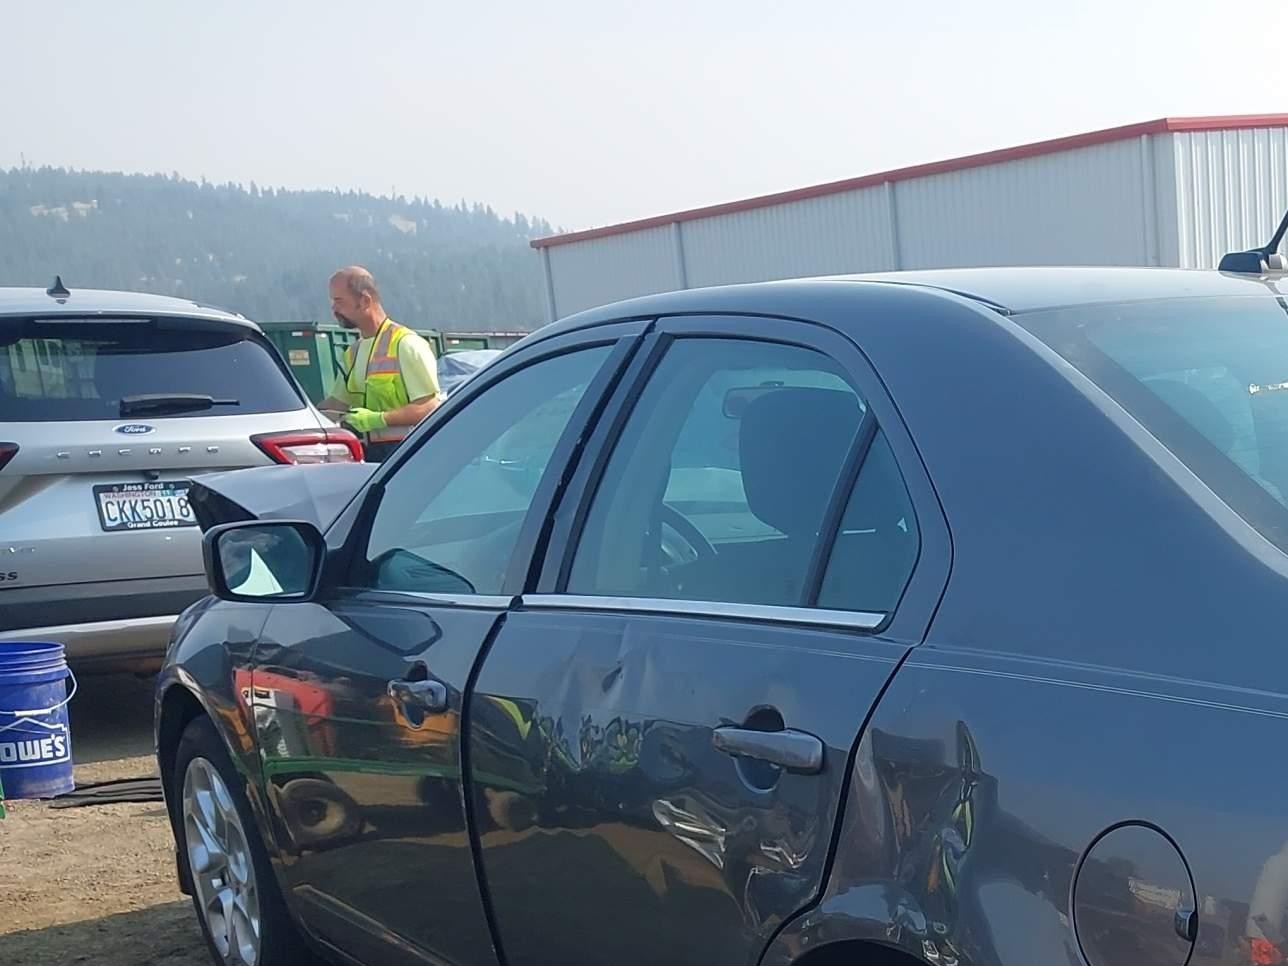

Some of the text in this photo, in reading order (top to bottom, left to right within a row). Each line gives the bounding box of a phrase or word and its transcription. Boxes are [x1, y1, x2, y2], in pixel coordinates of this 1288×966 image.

[104, 497, 190, 523] CKK5018
[127, 519, 179, 529] Grand Coulee
[0, 733, 66, 762] OWE'S
